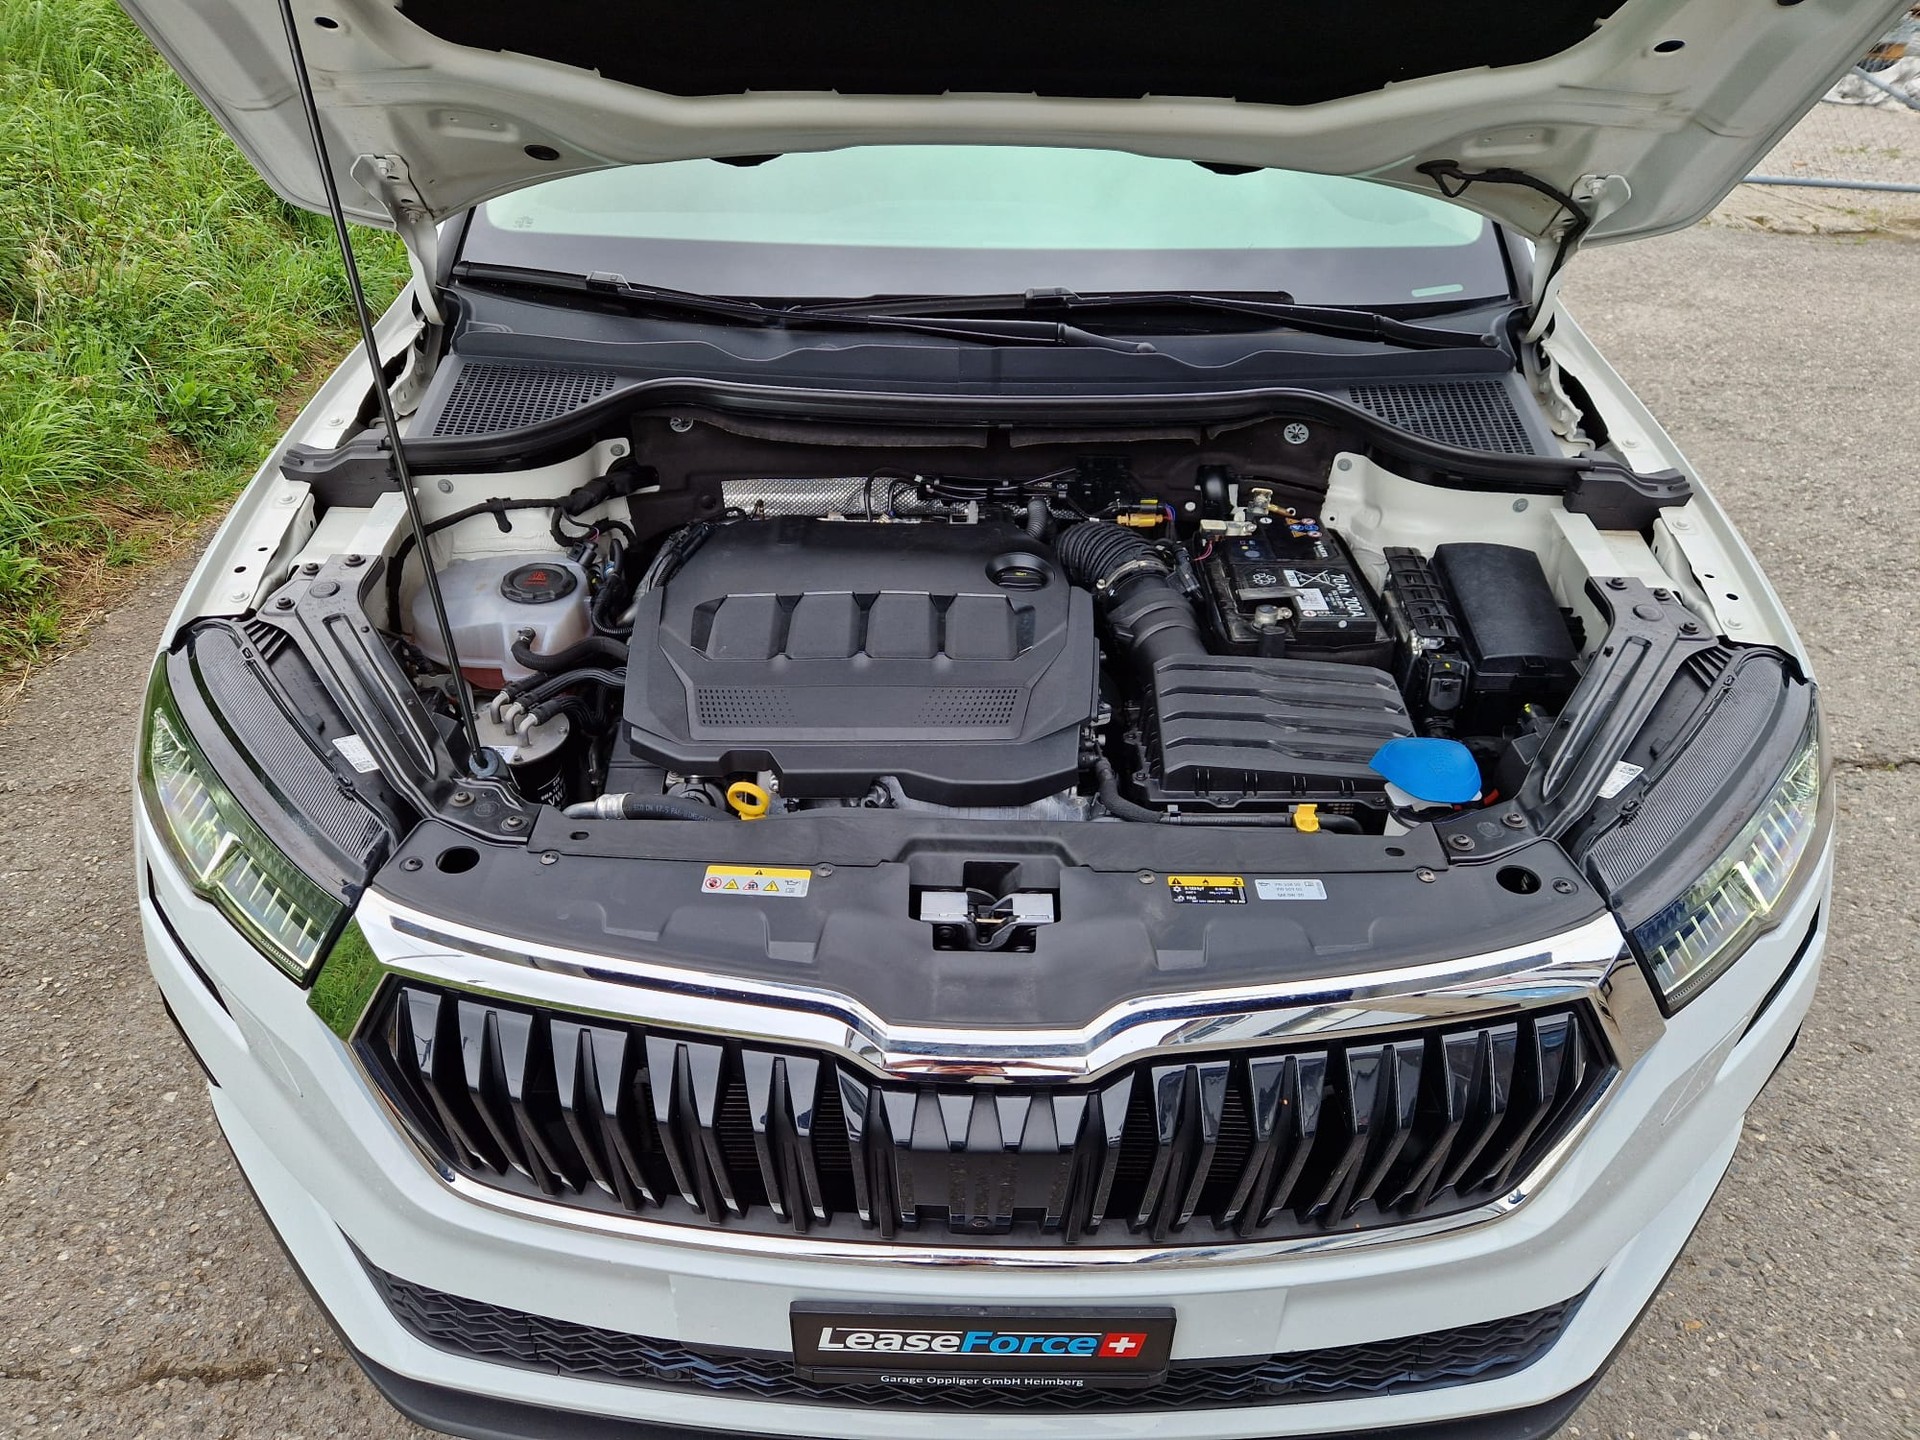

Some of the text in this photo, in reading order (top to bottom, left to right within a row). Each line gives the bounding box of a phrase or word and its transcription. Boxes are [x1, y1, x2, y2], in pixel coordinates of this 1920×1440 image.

[1330, 573, 1353, 594] 70Ah
[1342, 596, 1366, 617] 700A
[818, 1327, 1098, 1354] LeaseForce
[880, 1375, 1084, 1387] Garage Oppliger GmbH Heimberg
